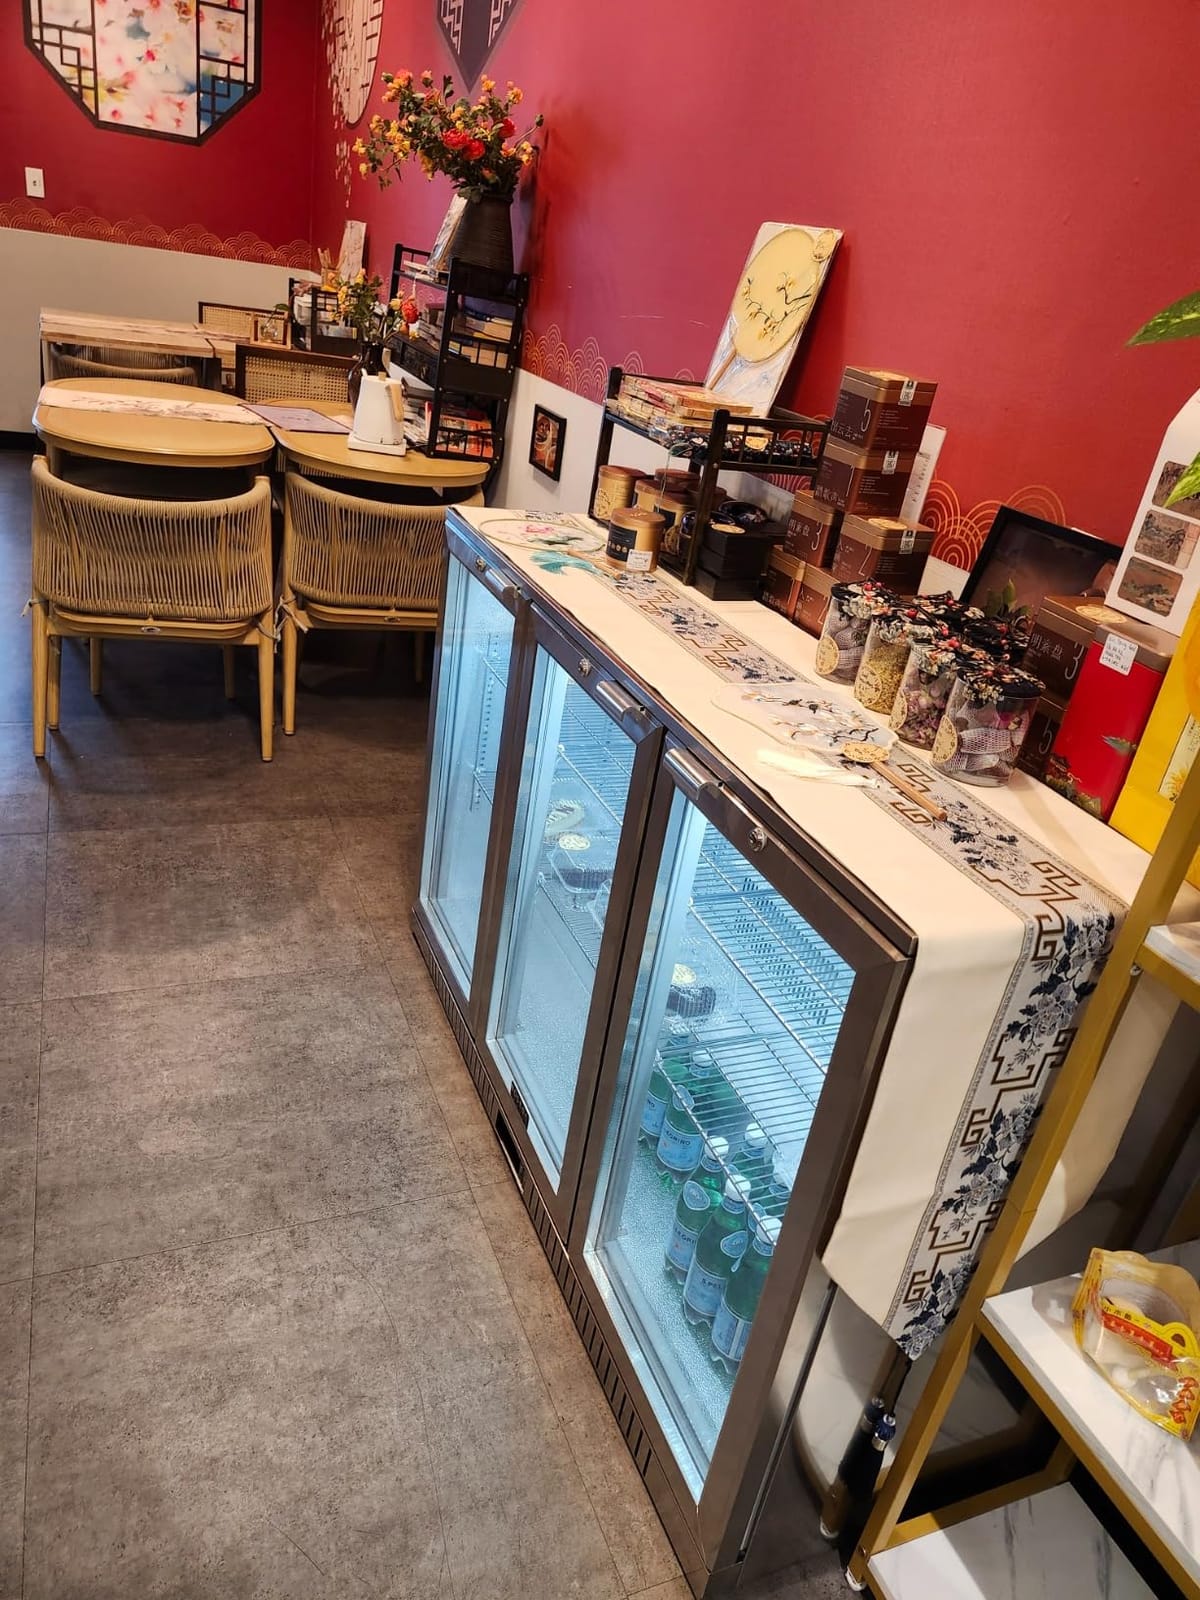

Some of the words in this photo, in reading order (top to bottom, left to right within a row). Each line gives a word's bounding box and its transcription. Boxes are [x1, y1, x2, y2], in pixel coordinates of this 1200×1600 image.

[811, 520, 823, 550] 3
[1065, 642, 1085, 680] 3
[1038, 718, 1052, 755] 5
